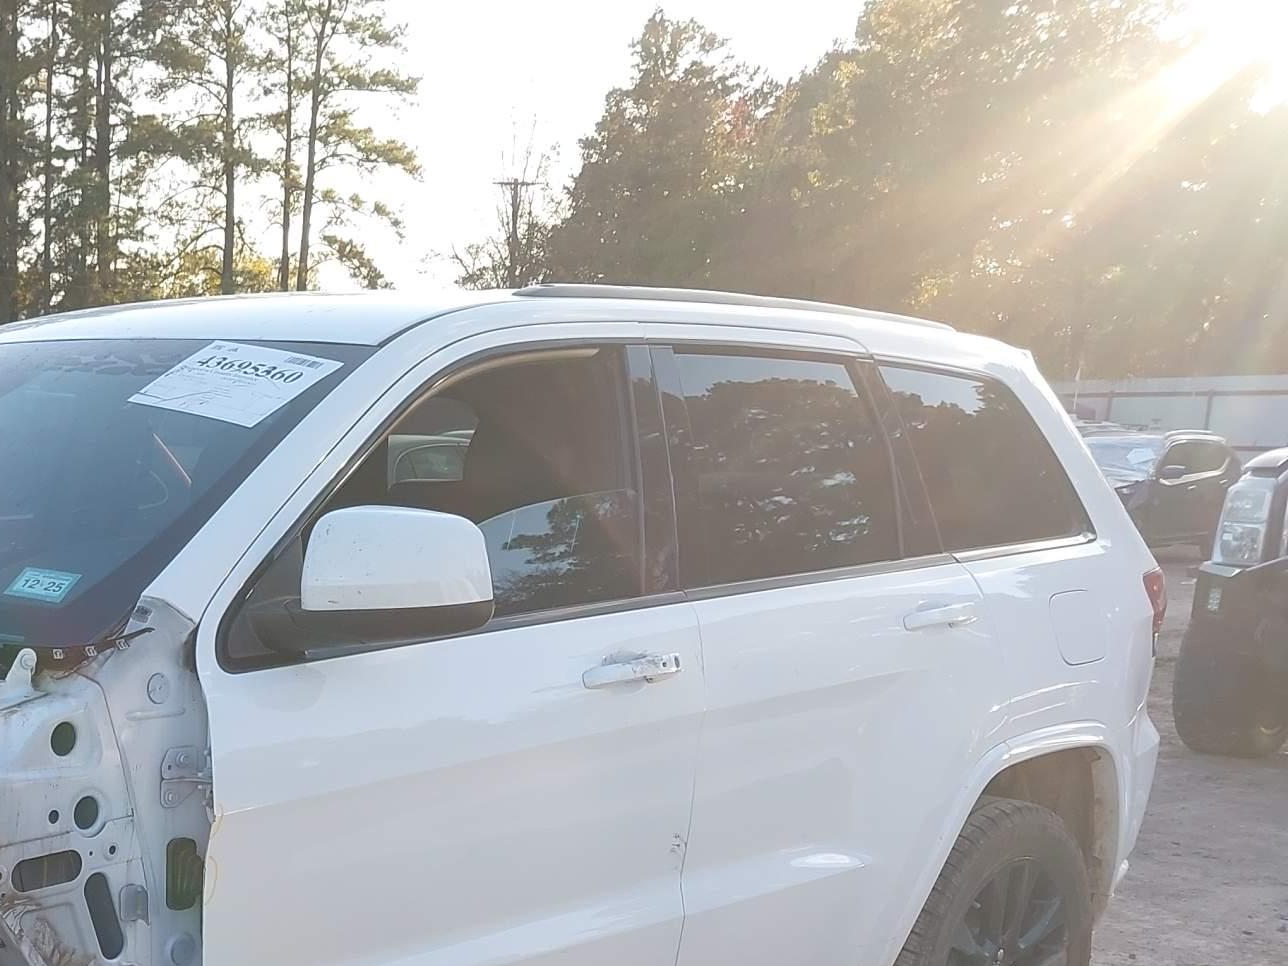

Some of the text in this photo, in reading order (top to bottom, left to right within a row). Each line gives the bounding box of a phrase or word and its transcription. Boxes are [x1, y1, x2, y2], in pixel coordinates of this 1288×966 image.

[197, 355, 304, 384] 43695360
[22, 578, 66, 593] 12 25
